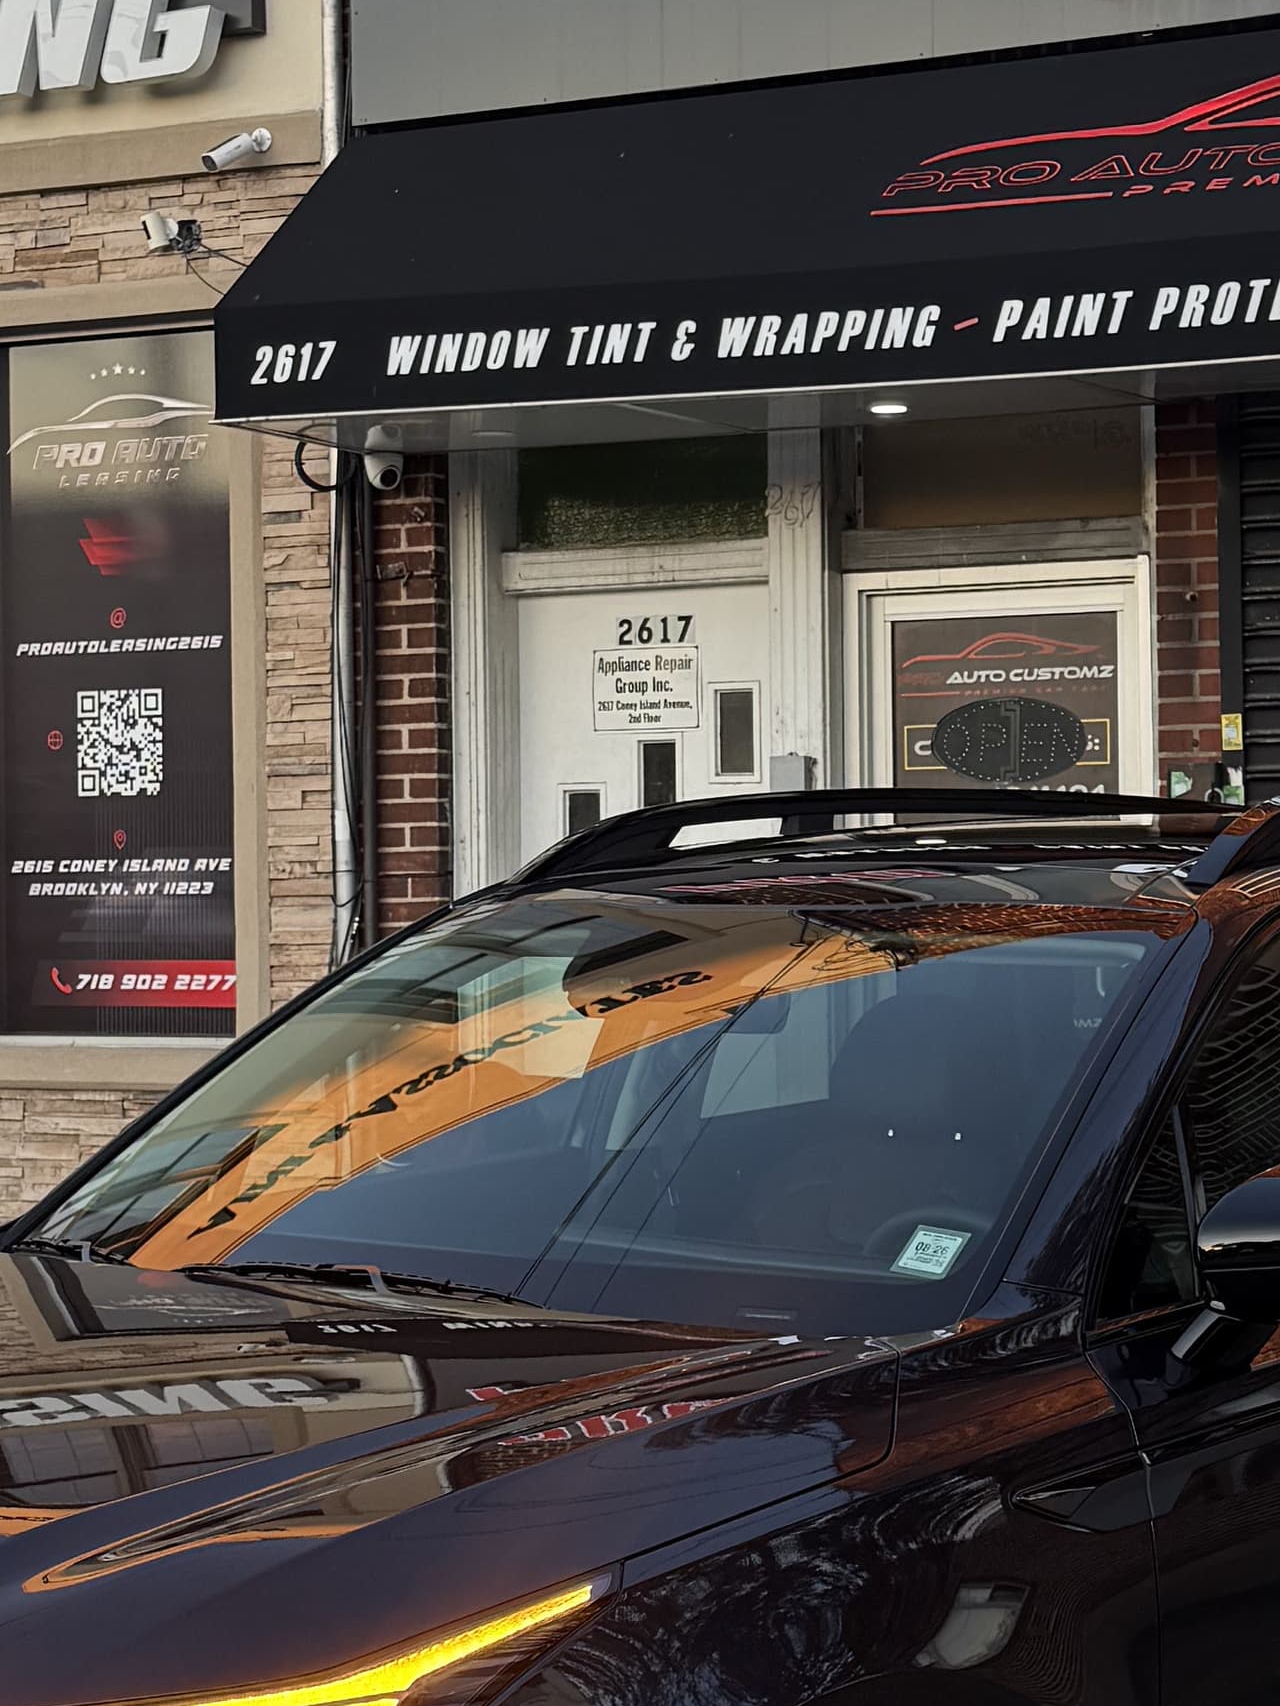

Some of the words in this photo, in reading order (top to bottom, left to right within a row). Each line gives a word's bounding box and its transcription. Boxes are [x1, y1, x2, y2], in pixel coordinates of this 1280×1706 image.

[882, 160, 1062, 197] PRO
[249, 339, 337, 387] 2617
[386, 327, 550, 378] WINDOW
[565, 320, 657, 367] TINT
[670, 319, 698, 362] &
[717, 304, 942, 359] WRAPPING
[992, 289, 1133, 344] PAINT
[32, 440, 107, 470] PRO
[111, 433, 209, 465] AUTO
[59, 467, 181, 489] LEASING
[618, 614, 694, 646] 2617
[15, 634, 224, 657] PROAUTOLEASING2615
[597, 655, 651, 677] Appliance
[654, 653, 694, 674] Repair
[945, 669, 1006, 685] AUTO
[1008, 664, 1116, 682] CUSTOMZ
[615, 676, 649, 697] Group
[652, 675, 674, 693] Inc.
[639, 699, 661, 710] Island
[643, 713, 662, 724] Floor
[942, 721, 1081, 763] OPEN
[10, 859, 55, 874] 2615
[58, 858, 118, 873] CONEY
[122, 857, 190, 872] ISLAND
[194, 857, 233, 872] AVE
[28, 882, 129, 897] BROOKLYN,
[134, 881, 158, 895] NY
[163, 881, 215, 895] 11223
[76, 973, 115, 990] 718
[120, 973, 169, 991] 902
[174, 973, 237, 991] 2277
